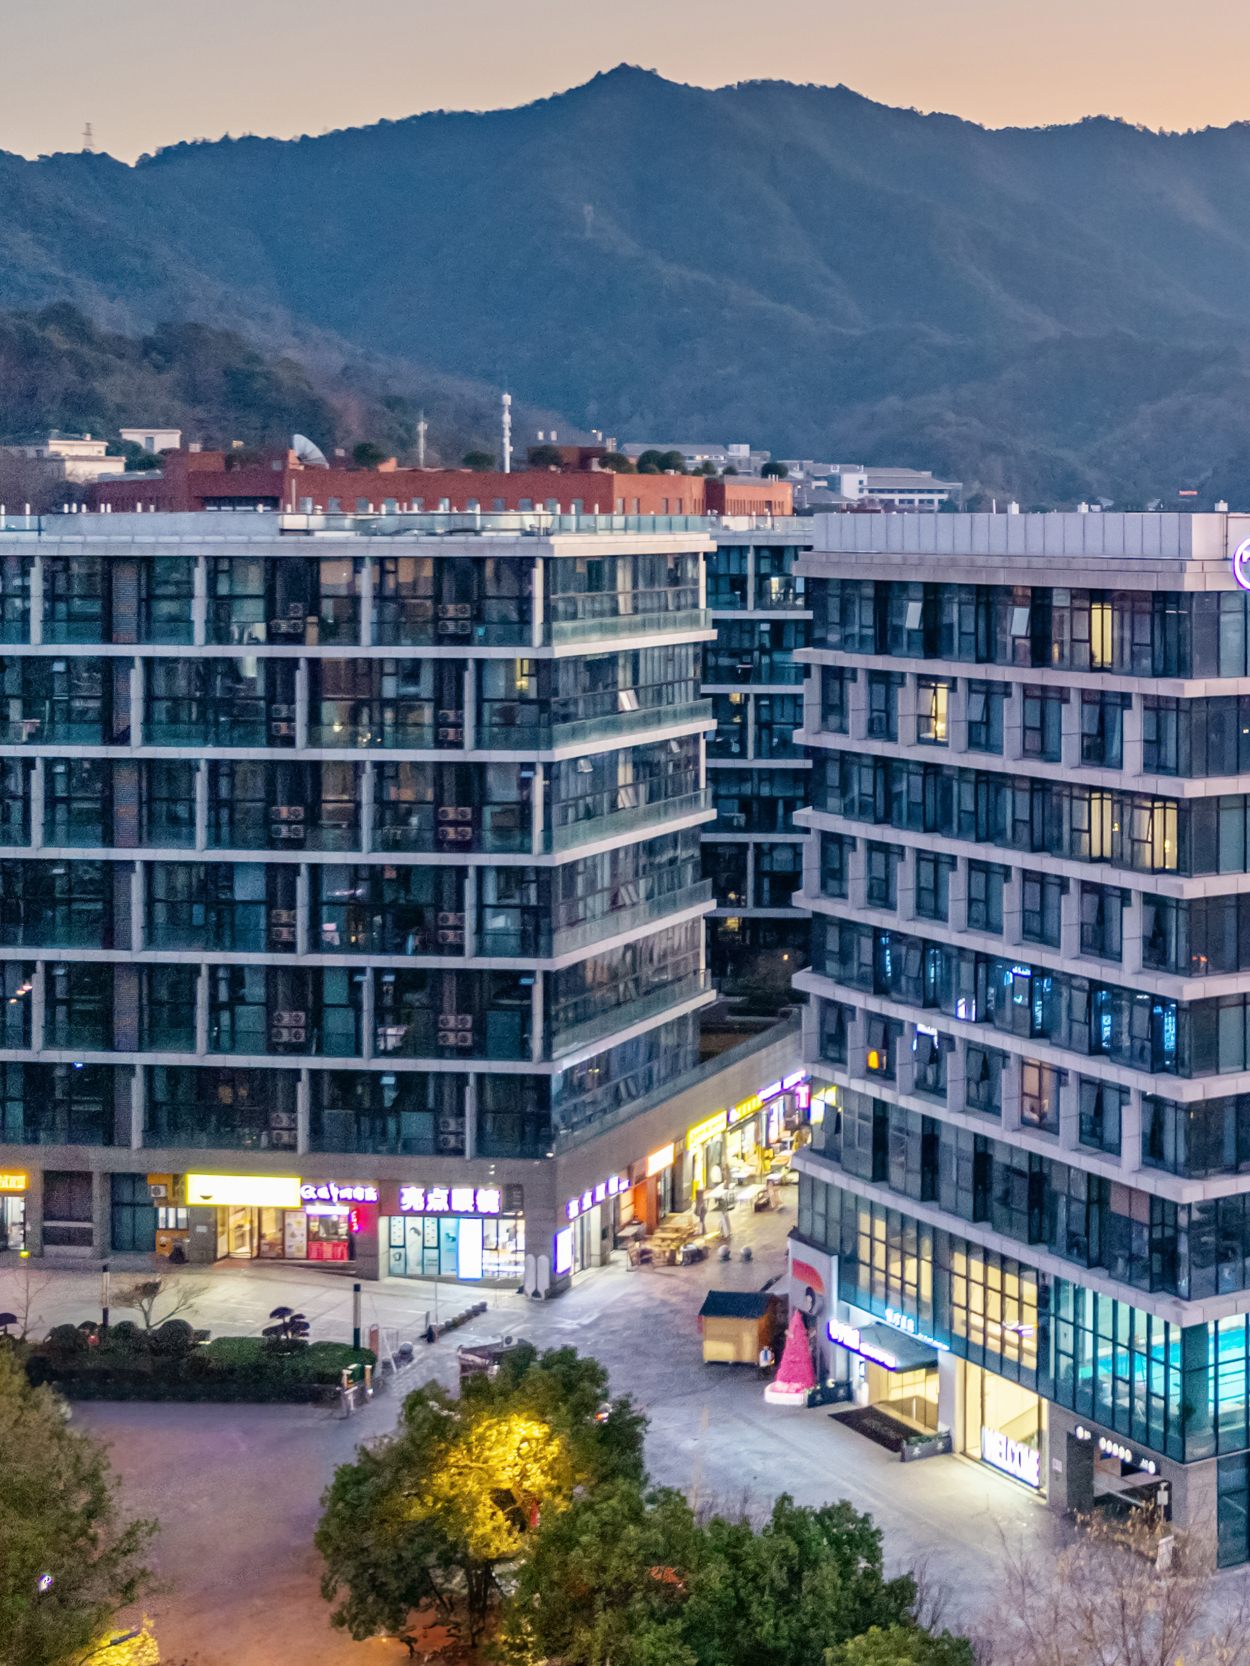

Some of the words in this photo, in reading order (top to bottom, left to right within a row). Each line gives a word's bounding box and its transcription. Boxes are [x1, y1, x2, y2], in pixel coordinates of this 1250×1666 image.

[399, 1186, 501, 1215] 亮点眼镜
[981, 1426, 1041, 1487] WELCOME
